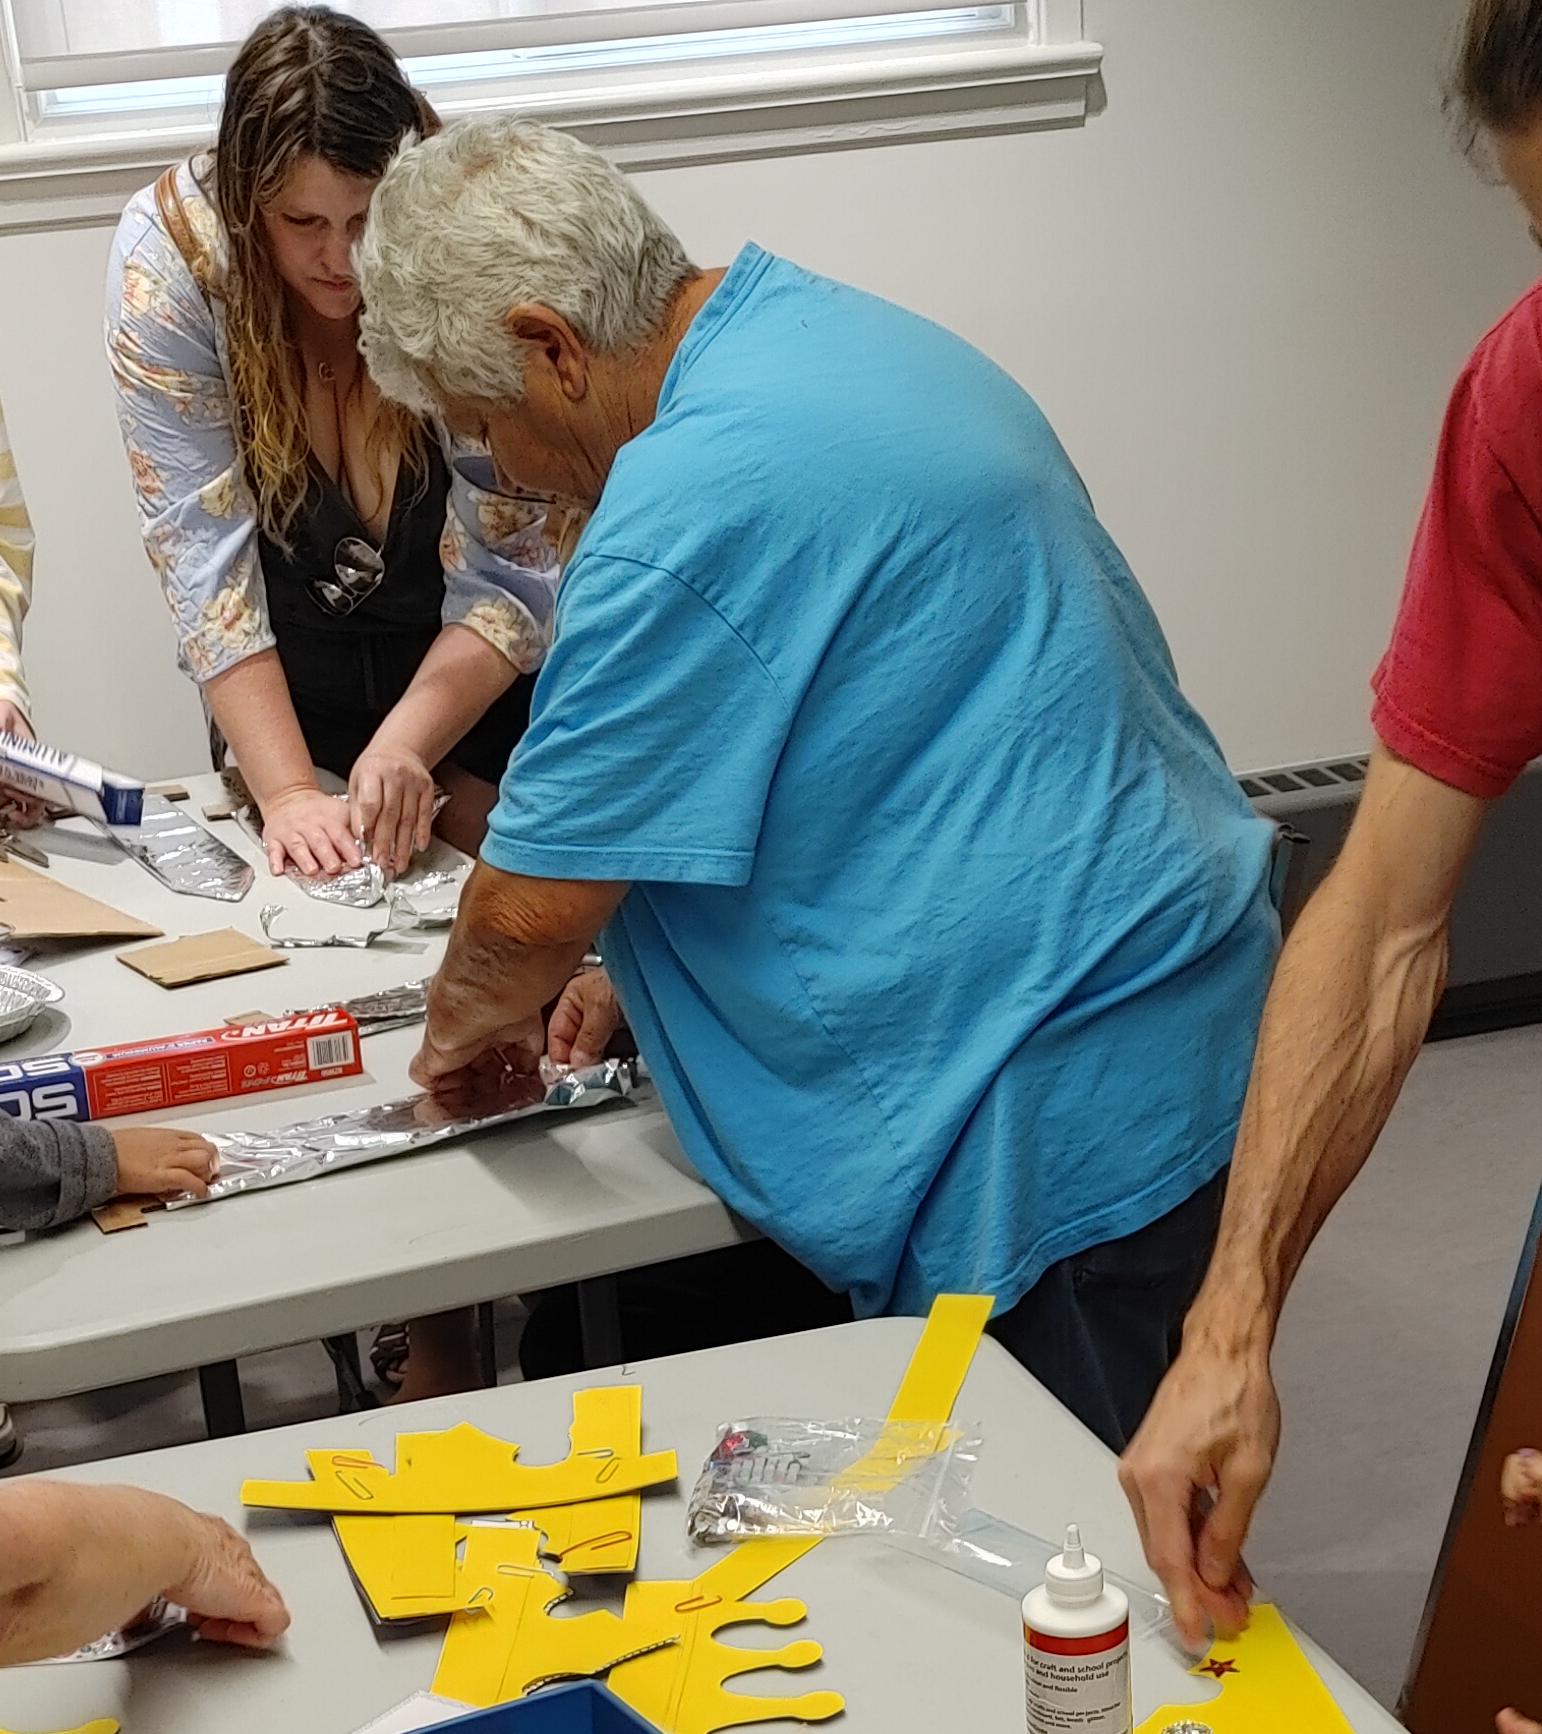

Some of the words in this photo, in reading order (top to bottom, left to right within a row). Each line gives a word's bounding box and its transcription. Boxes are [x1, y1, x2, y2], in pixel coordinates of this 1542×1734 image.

[240, 1010, 348, 1038] TITAN
[1040, 1662, 1056, 1672] craft
[1077, 1661, 1103, 1673] school
[1050, 1672, 1094, 1681] household
[1096, 1671, 1109, 1679] use
